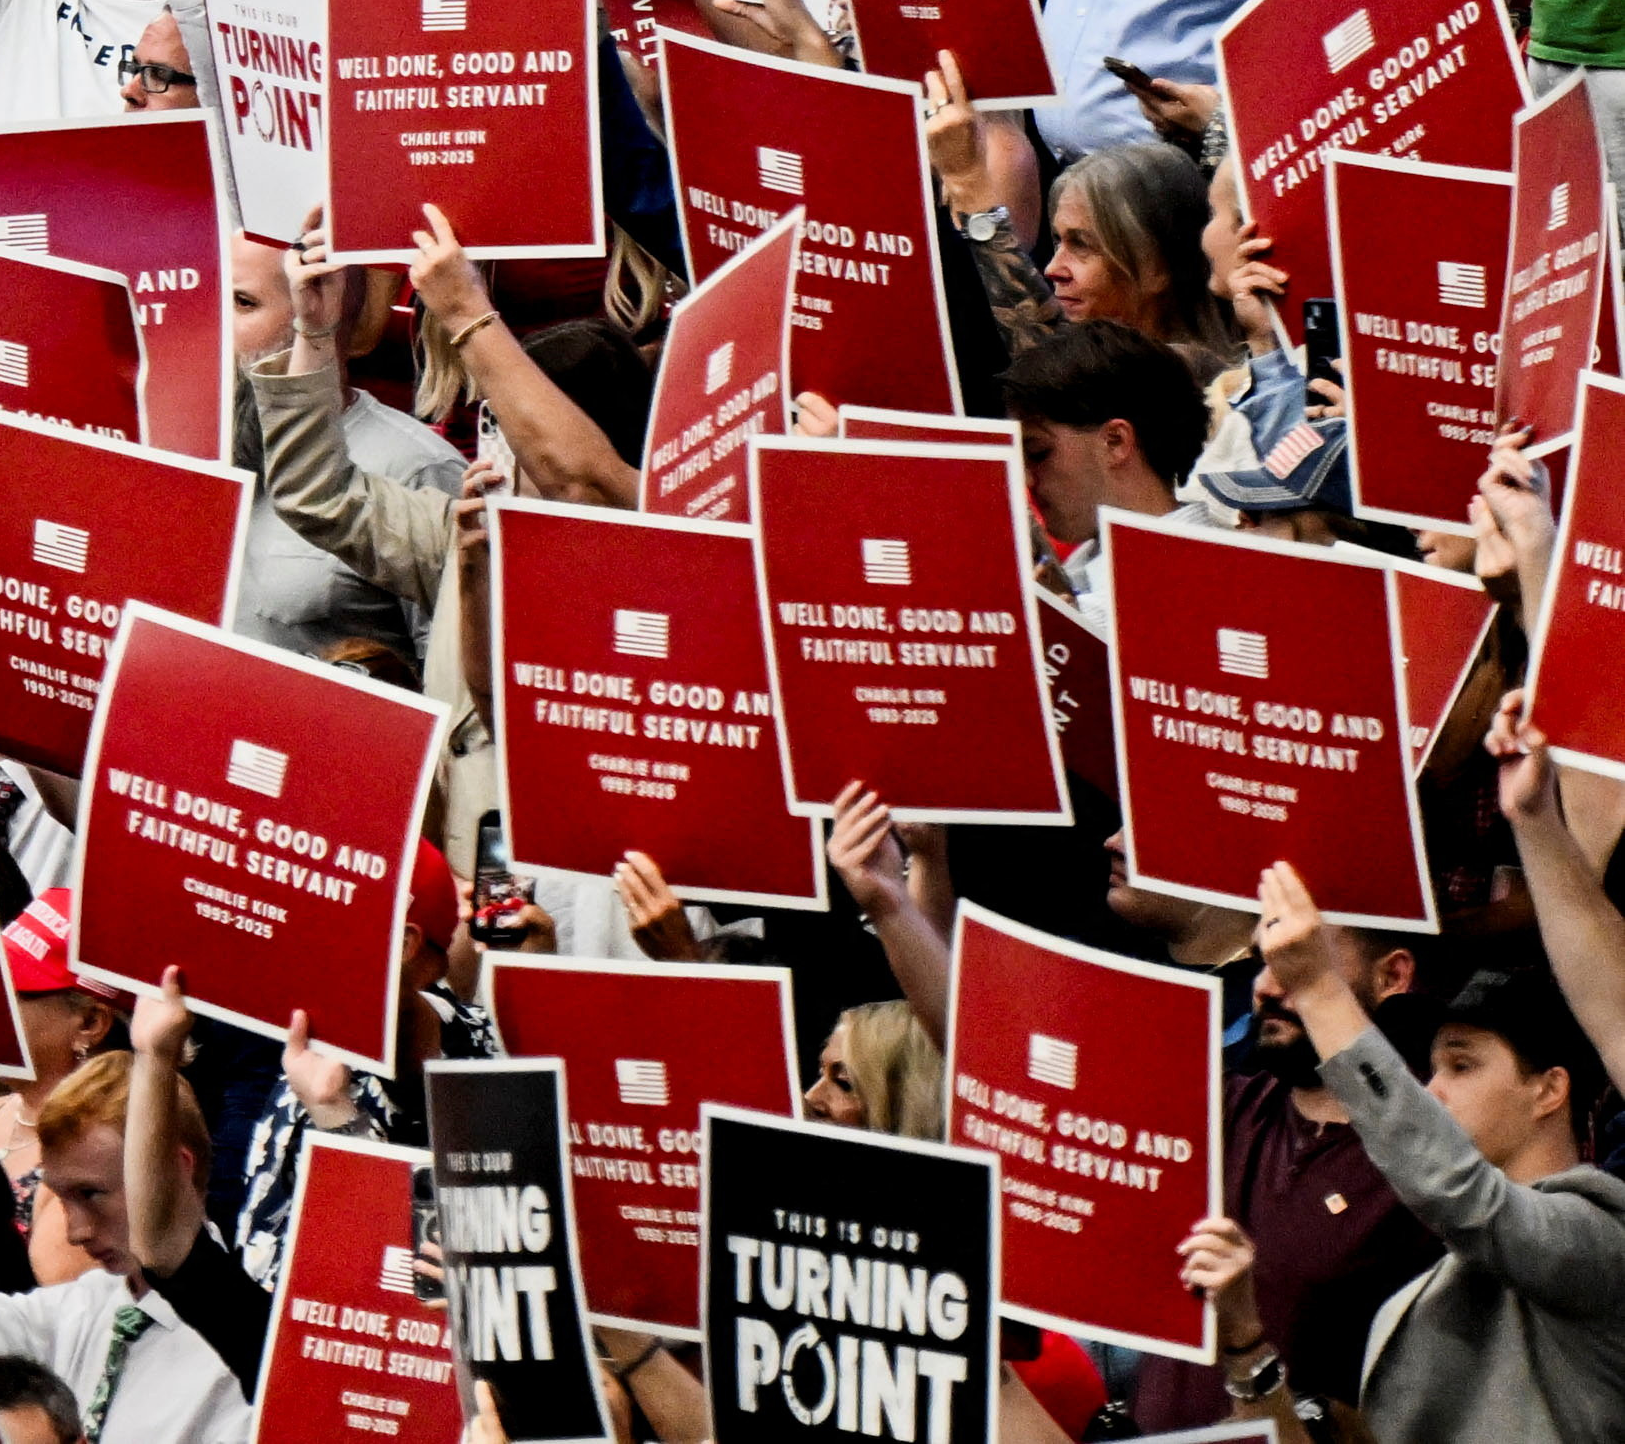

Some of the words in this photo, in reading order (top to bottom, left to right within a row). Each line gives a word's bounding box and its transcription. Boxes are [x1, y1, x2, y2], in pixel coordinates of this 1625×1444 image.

[339, 58, 381, 79] WELL
[386, 54, 444, 78] DONE,
[452, 52, 515, 75] GOOD
[525, 51, 572, 72] AND
[356, 88, 440, 111] FAITHFUL
[447, 84, 547, 108] SERVANT
[400, 132, 450, 146] CHARLIE
[455, 131, 485, 144] KIRK
[1130, 677, 1180, 708] WELL
[1254, 701, 1322, 733] GOOD
[1331, 714, 1383, 741] AND
[1152, 715, 1247, 755] FAITHFUL
[1252, 734, 1358, 771] SERVANT
[775, 1209, 826, 1239] THIS
[838, 1220, 861, 1244] IS
[871, 1226, 919, 1253] OUR
[728, 1235, 968, 1341] TURNING
